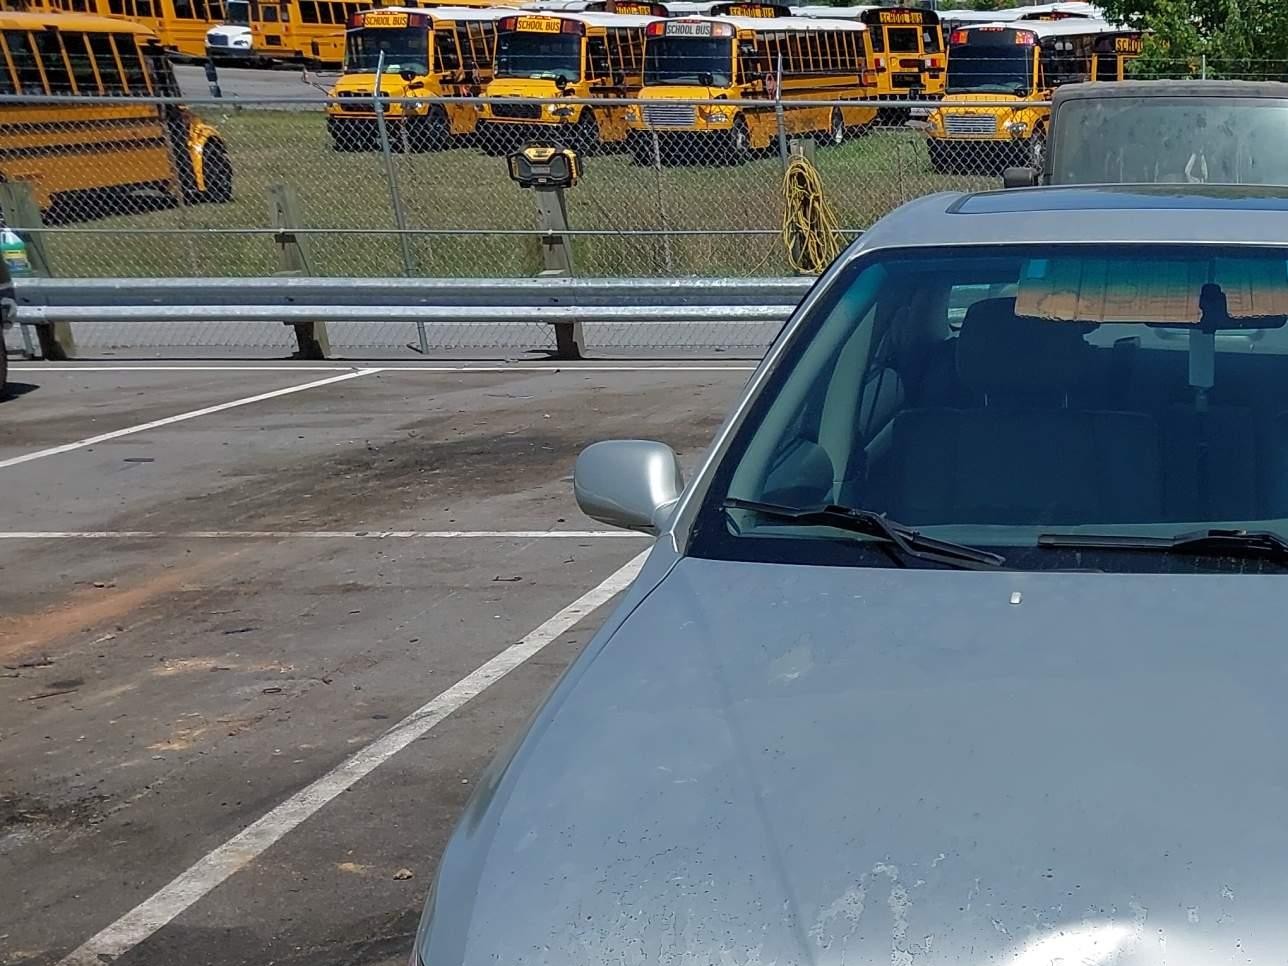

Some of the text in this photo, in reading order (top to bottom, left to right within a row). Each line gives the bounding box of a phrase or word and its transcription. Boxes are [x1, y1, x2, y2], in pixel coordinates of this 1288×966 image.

[366, 16, 407, 26] SCHOOL BUS
[518, 19, 560, 31] SCHOOL BUS
[666, 24, 710, 36] SCHOOL BUS
